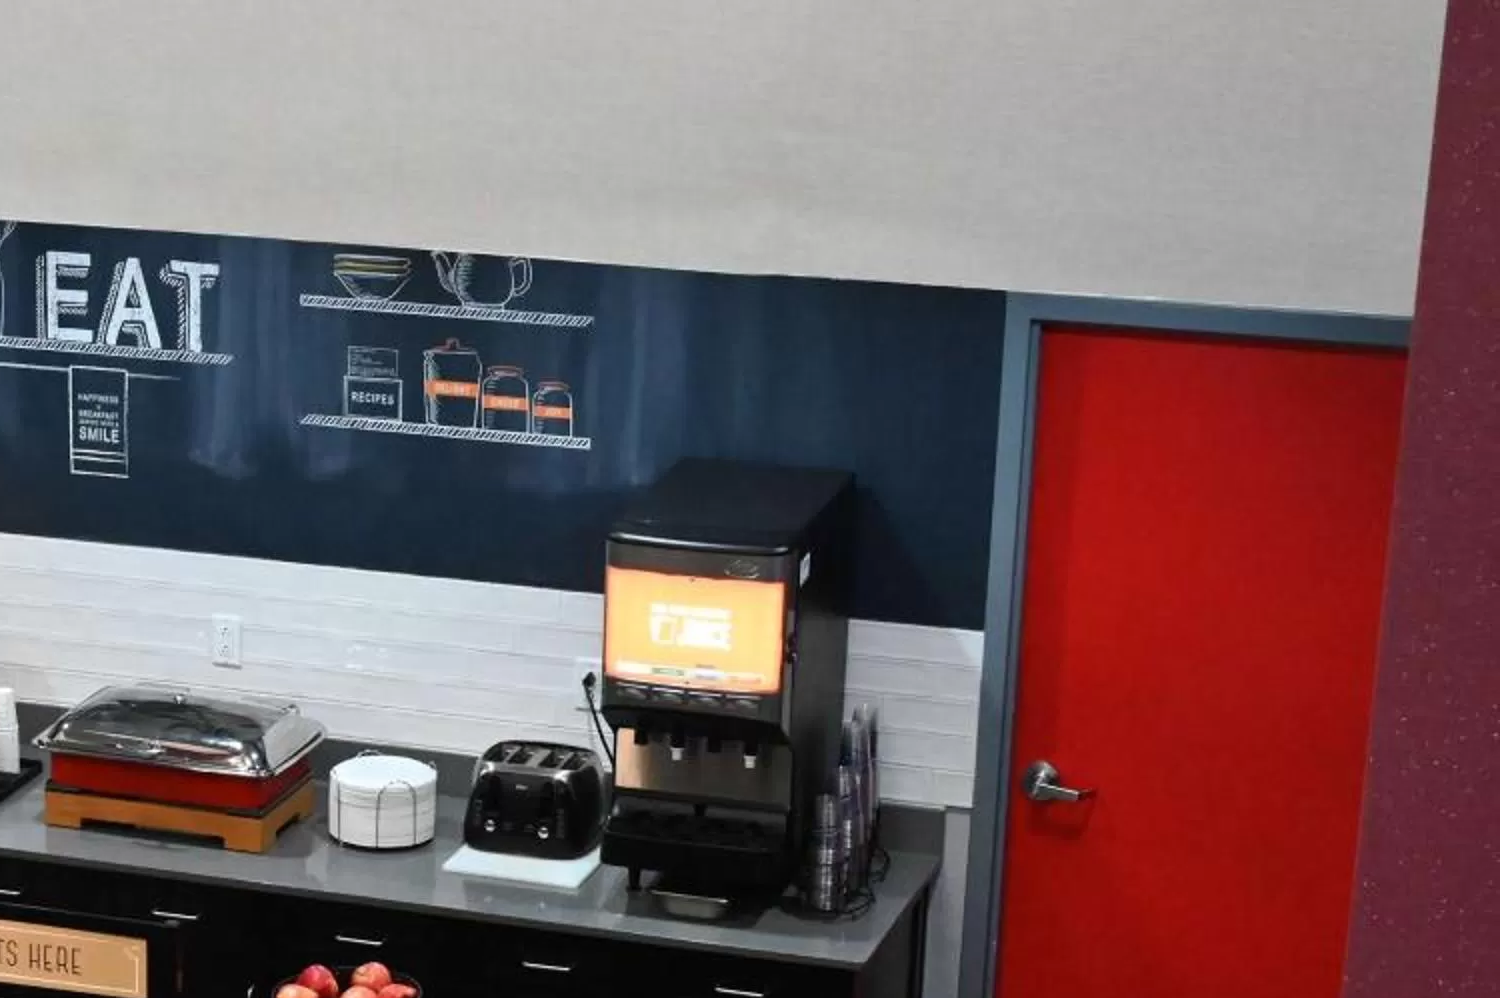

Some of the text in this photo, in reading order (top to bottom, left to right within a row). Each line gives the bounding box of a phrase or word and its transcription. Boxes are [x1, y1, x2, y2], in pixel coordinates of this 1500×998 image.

[36, 250, 220, 353] EAT
[350, 391, 395, 406] RECIPES
[79, 425, 120, 444] SMILE
[28, 943, 83, 977] HERE
